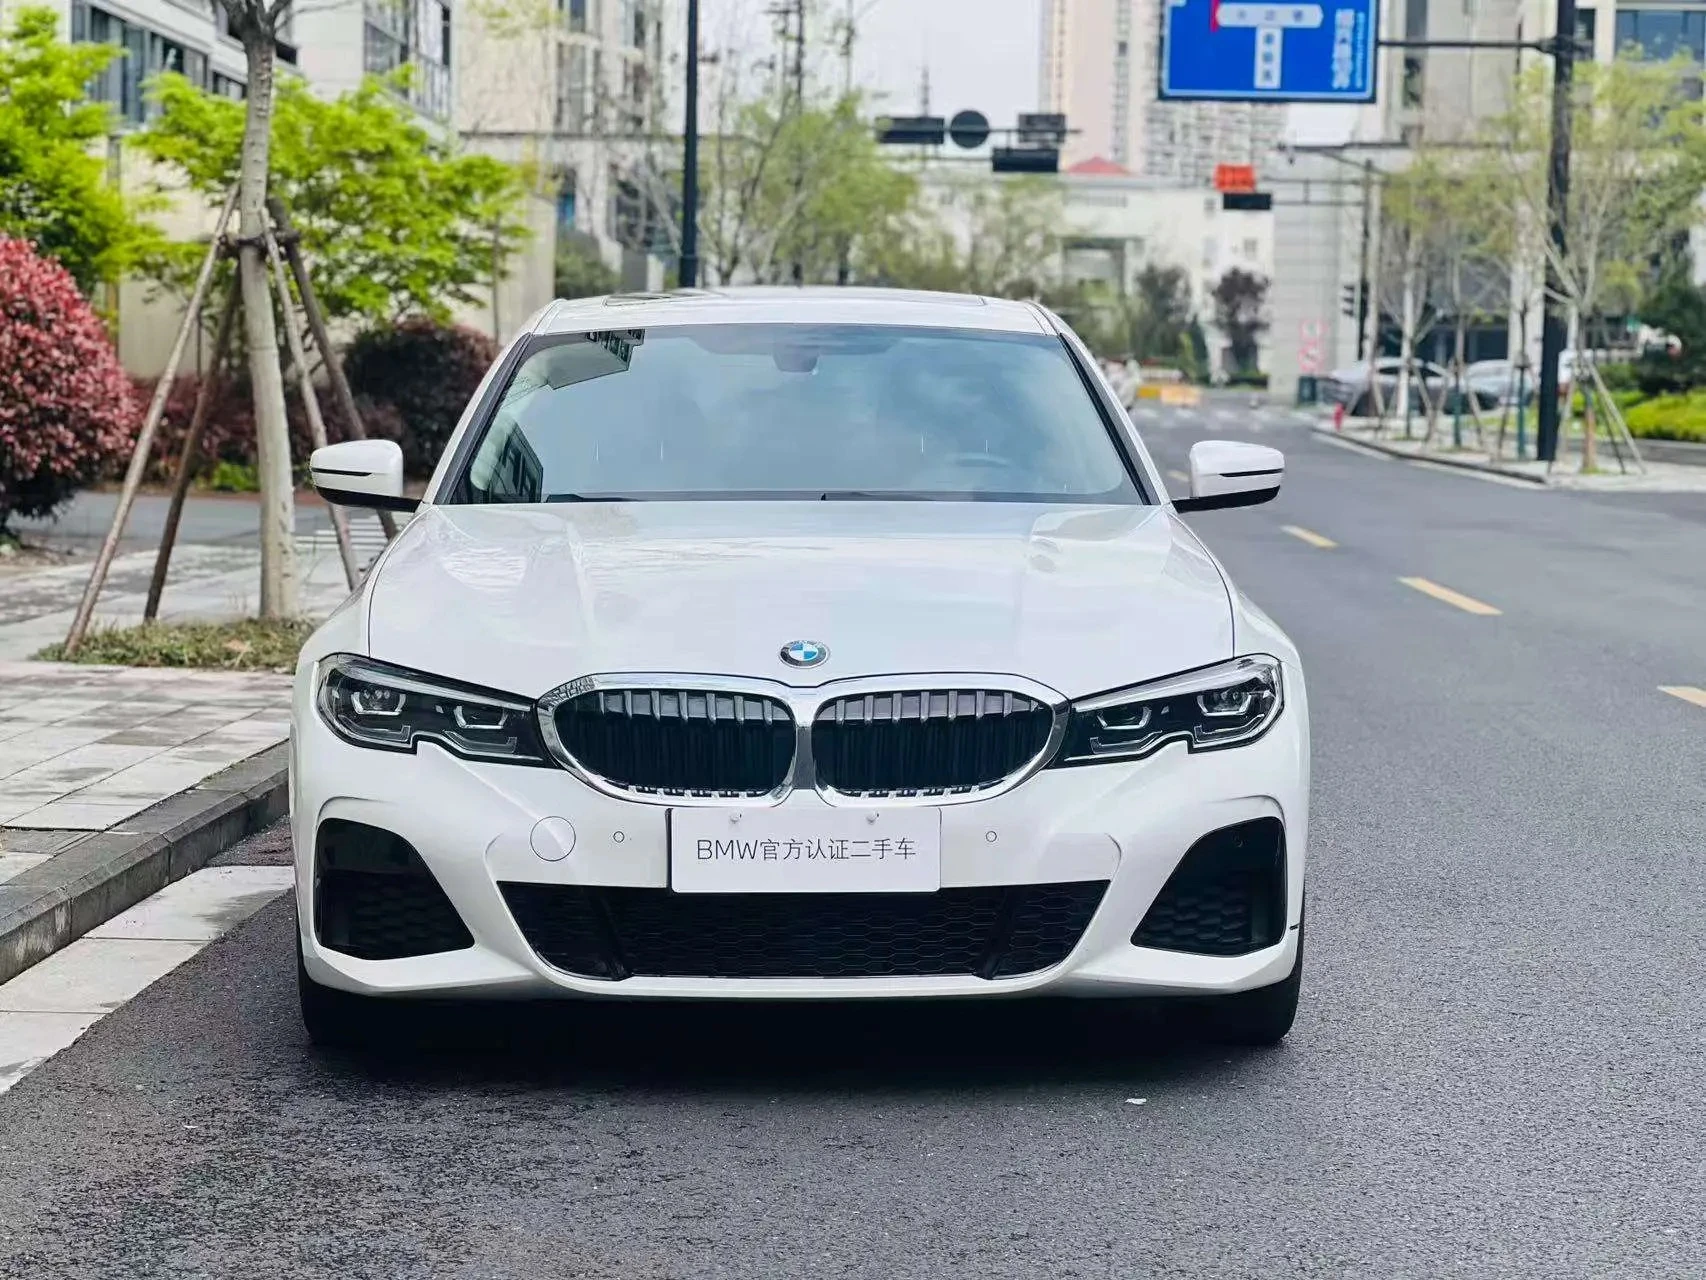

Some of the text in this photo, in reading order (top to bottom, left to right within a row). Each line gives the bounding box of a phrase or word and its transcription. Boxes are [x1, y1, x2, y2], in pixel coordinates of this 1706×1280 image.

[696, 837, 917, 861] BMW官方认证二手车
